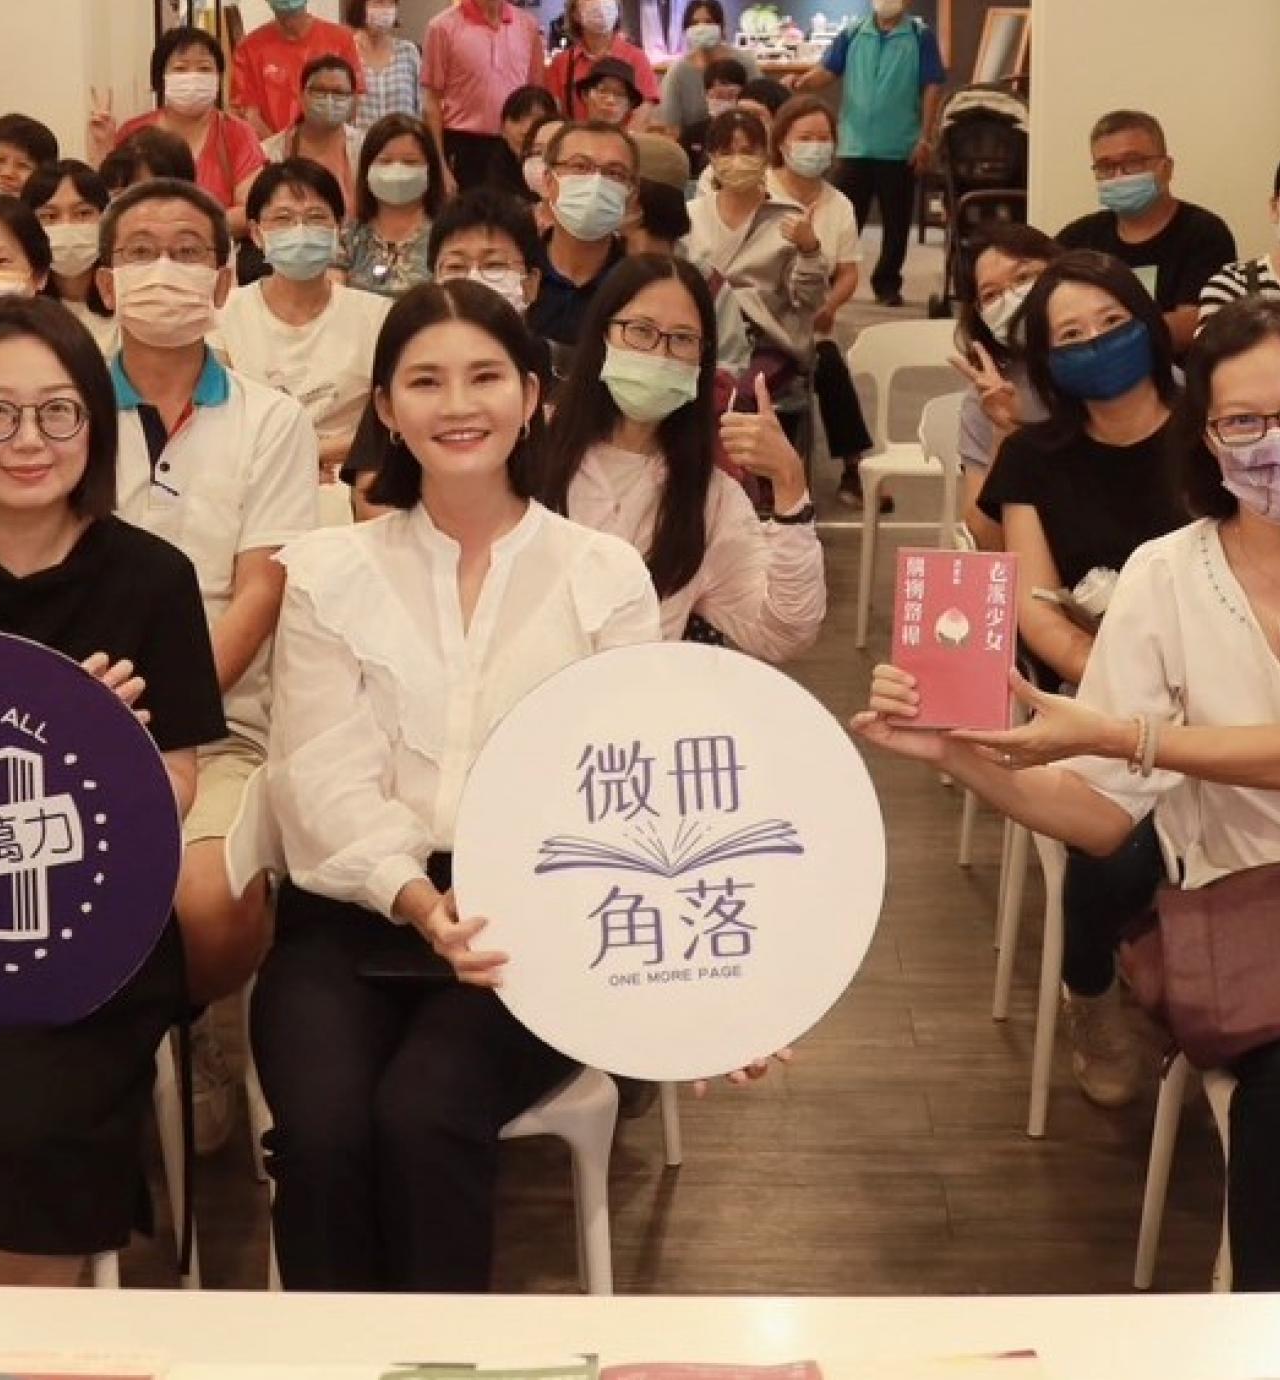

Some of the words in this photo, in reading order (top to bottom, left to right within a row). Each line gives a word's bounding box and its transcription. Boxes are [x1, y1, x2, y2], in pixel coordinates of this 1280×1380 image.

[0, 707, 49, 744] ALL
[575, 735, 747, 823] 微冊
[587, 877, 758, 969] 角落
[608, 973, 640, 986] ONE
[647, 968, 692, 983] MORE
[698, 965, 742, 979] PAGE
